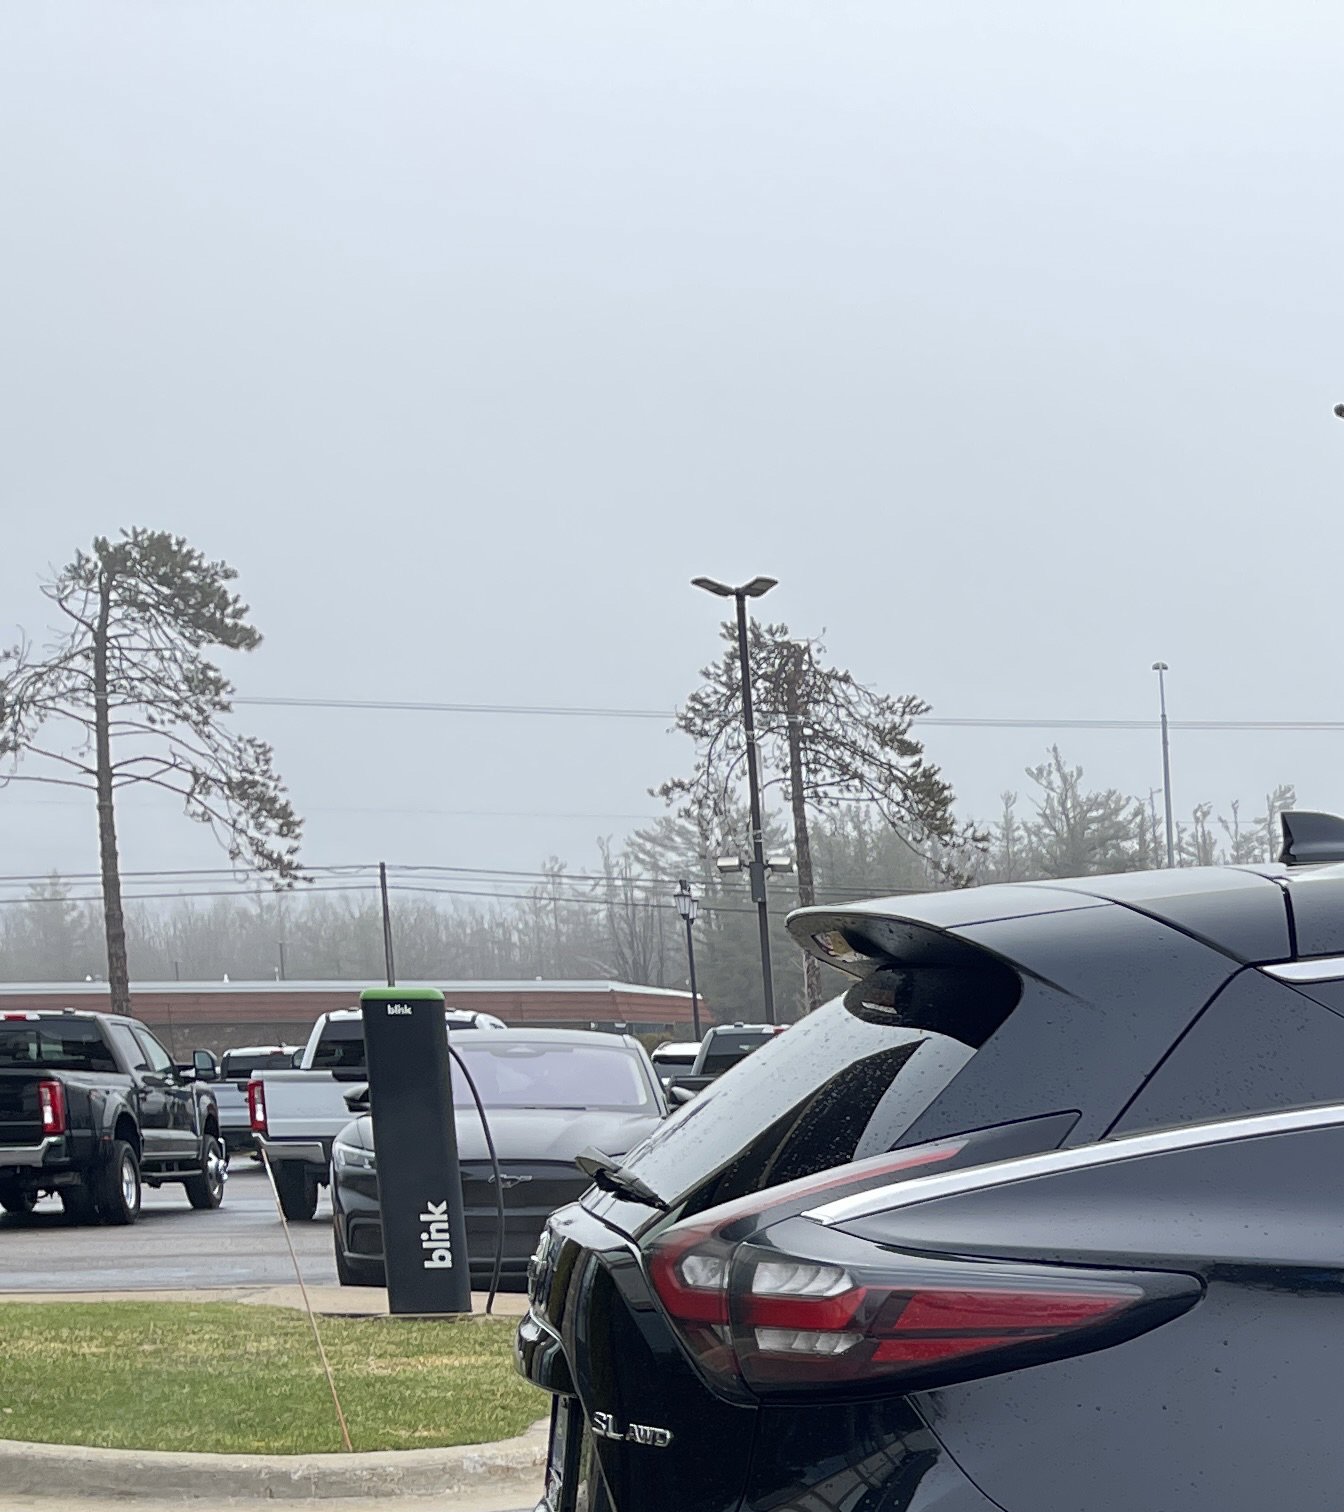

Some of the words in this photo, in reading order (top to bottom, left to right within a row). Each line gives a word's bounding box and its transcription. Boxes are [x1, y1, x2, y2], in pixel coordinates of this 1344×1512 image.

[387, 1003, 413, 1015] blink
[419, 1199, 453, 1269] blink
[591, 1411, 624, 1441] SL
[625, 1423, 674, 1448] AWD
